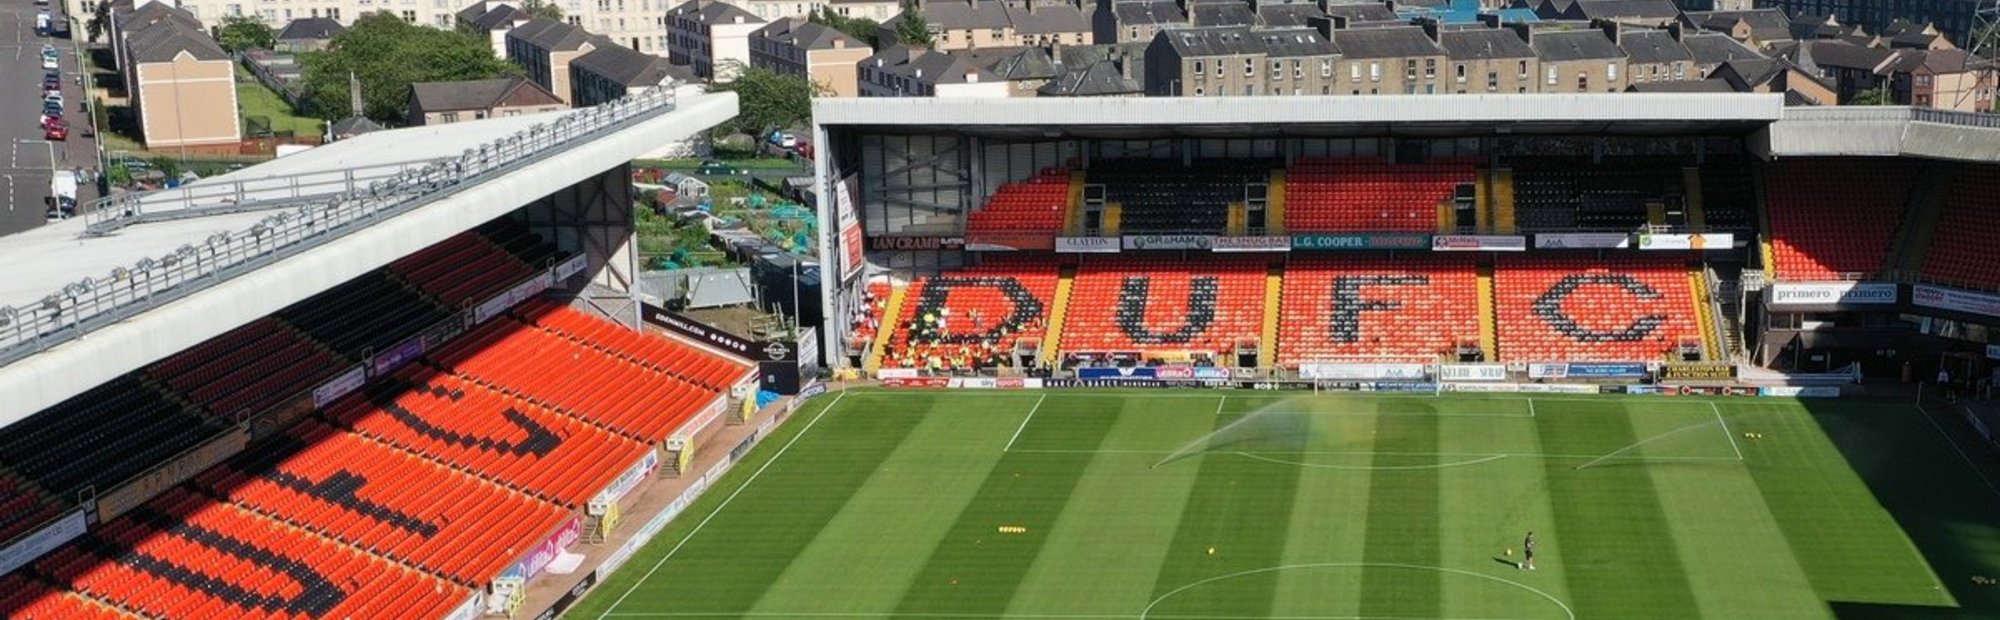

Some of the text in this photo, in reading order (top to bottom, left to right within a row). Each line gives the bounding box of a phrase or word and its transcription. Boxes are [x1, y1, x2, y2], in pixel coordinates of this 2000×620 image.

[873, 238, 897, 249] IAN
[899, 238, 940, 249] CRAMB
[1067, 238, 1108, 246] CLAYTON
[1146, 235, 1196, 244] GRAHAM
[1235, 237, 1266, 245] SNUG
[1293, 236, 1315, 247] L.G.
[1319, 236, 1364, 247] COOPER
[1778, 287, 1892, 300] primero primero
